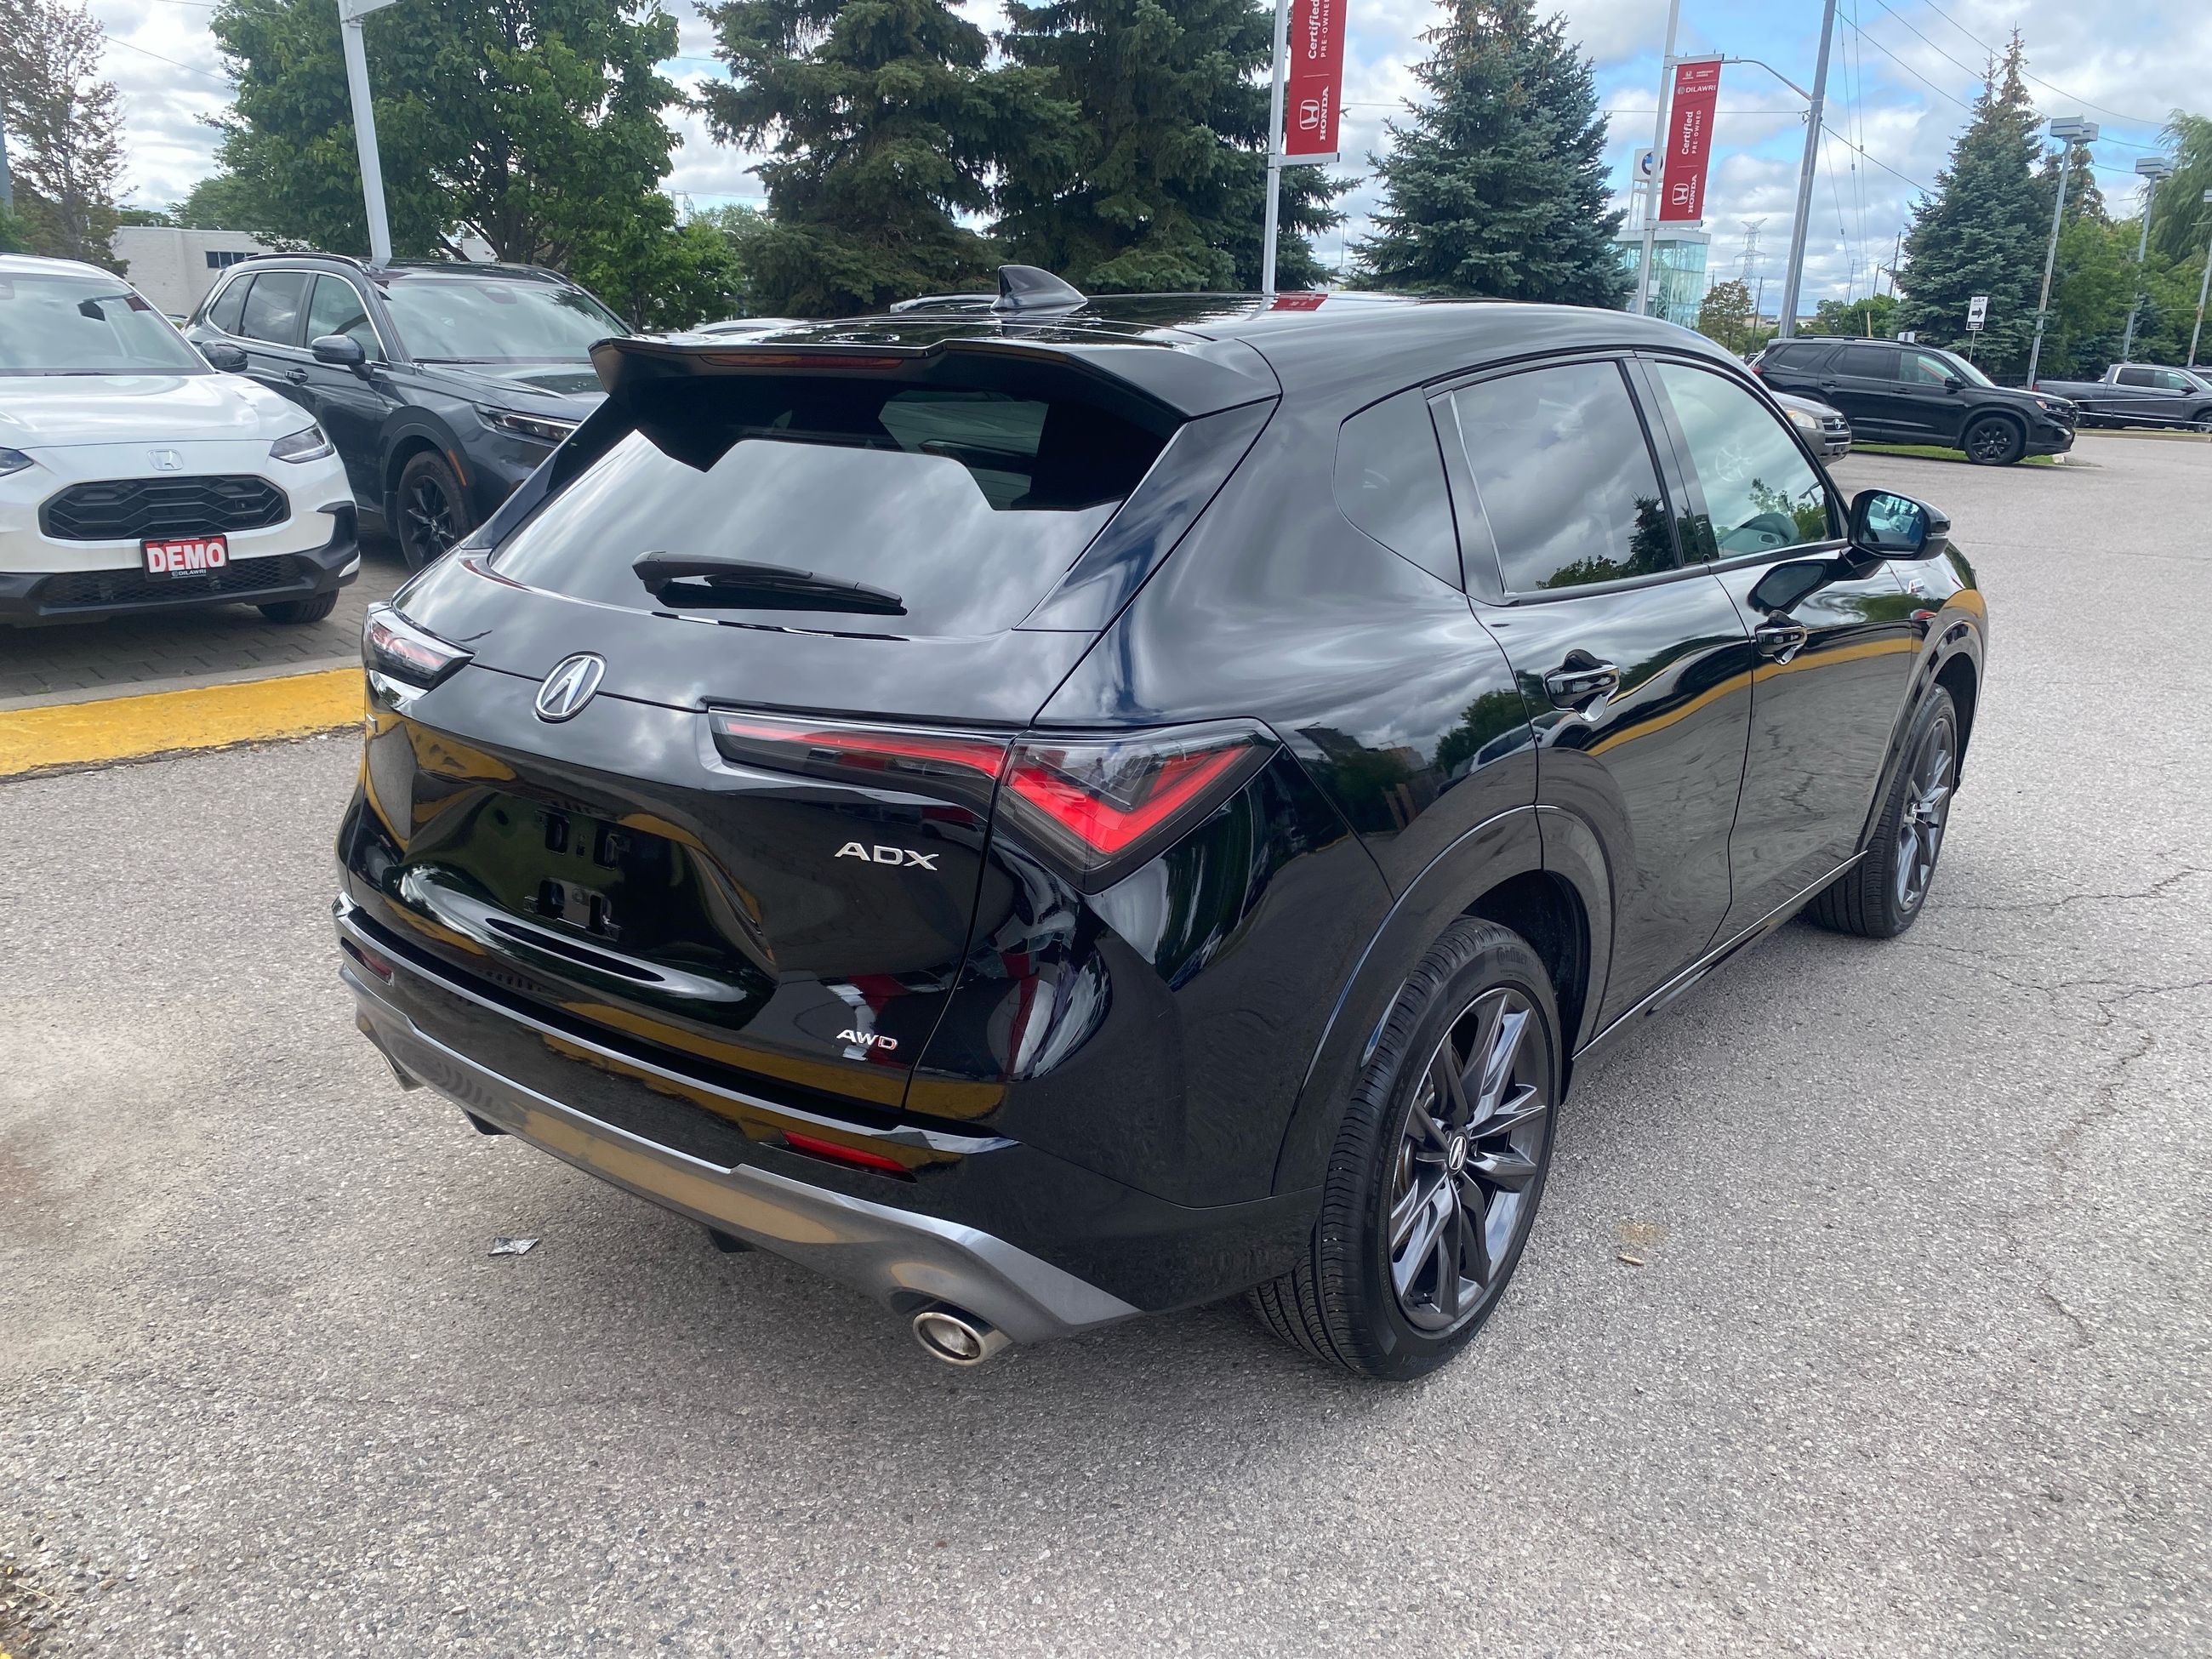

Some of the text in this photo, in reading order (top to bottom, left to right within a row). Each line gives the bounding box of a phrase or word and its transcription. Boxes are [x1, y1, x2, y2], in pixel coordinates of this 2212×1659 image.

[1308, 0, 1320, 60] Certified
[1685, 84, 1716, 94] DILAWRI
[1320, 86, 1329, 141] HONDA
[1681, 111, 1694, 155] Certified
[1691, 110, 1702, 155] PRE-OWNED
[1688, 174, 1698, 214] HONDA
[146, 542, 225, 573] DEMO
[834, 841, 939, 871] ADX
[836, 1029, 898, 1051] AWD
